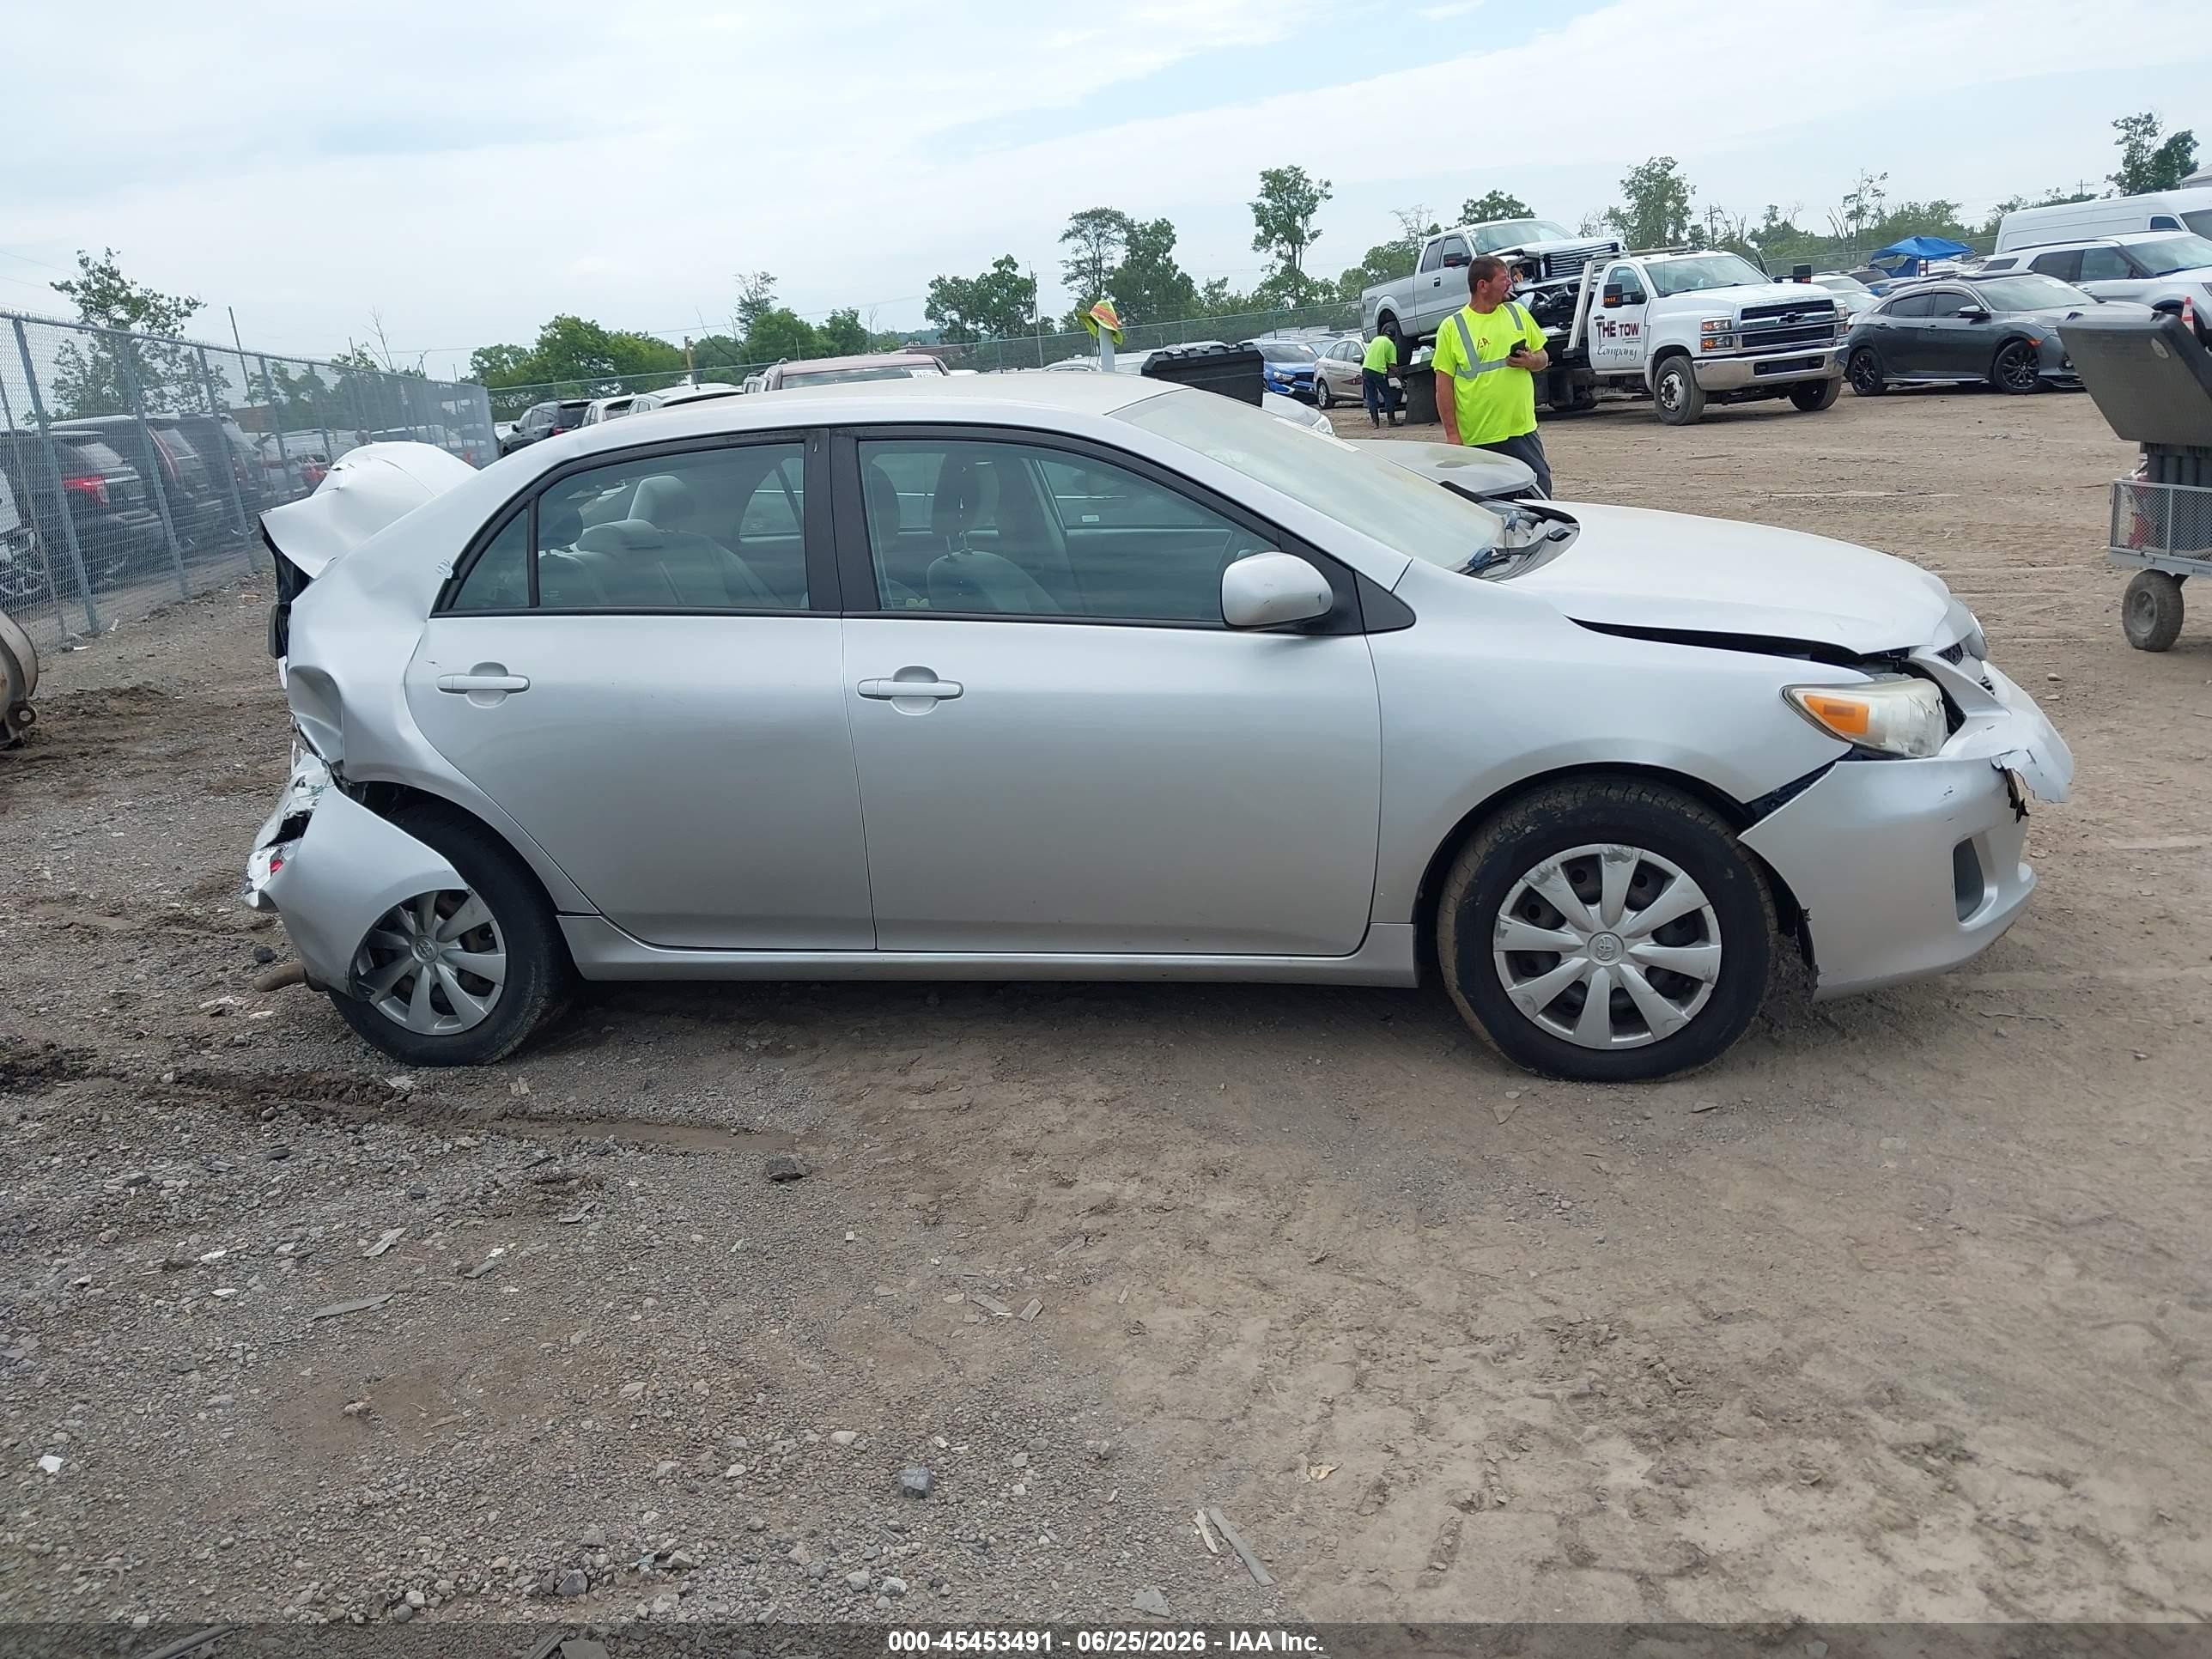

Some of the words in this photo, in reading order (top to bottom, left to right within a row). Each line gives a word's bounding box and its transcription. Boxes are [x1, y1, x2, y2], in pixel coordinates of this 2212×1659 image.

[1596, 320, 1616, 337] THE
[1619, 323, 1639, 337] TOW
[1597, 344, 1638, 361] Company
